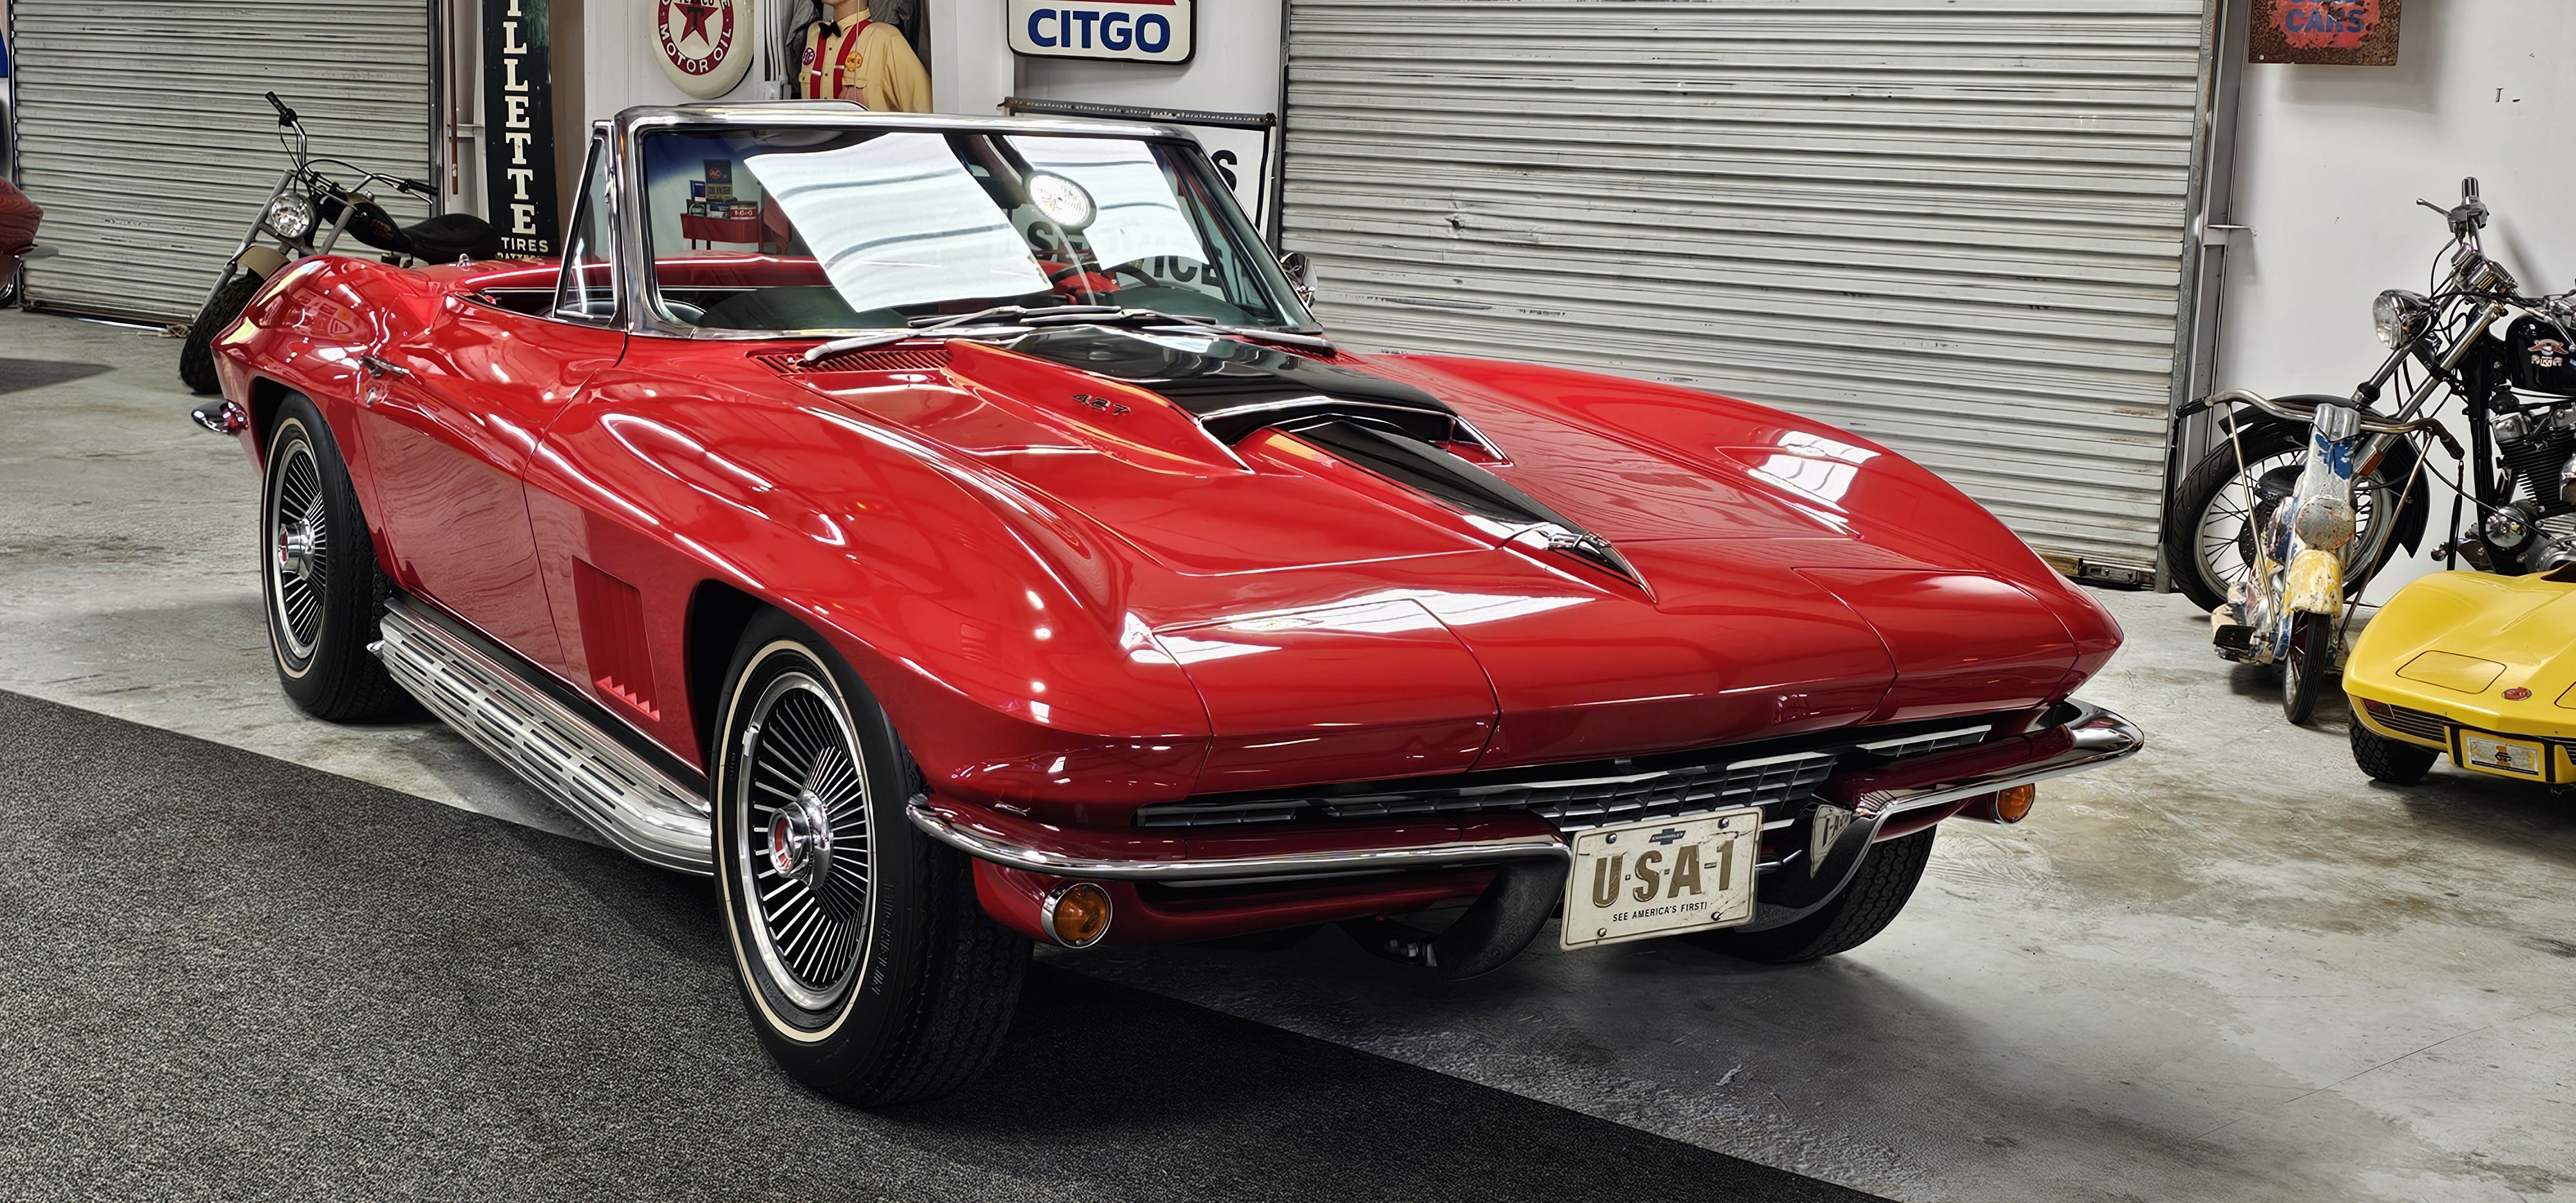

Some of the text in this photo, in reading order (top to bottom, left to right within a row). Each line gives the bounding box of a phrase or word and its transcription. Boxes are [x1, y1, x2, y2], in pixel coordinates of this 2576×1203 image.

[1028, 8, 1171, 53] CITGO
[2286, 9, 2364, 33] CARS
[659, 23, 732, 73] MOTOR OIL
[501, 237, 549, 252] TIRES
[1072, 394, 1132, 415] 427
[1613, 912, 1629, 922] SEE
[1632, 905, 1677, 920] AMERICA'S
